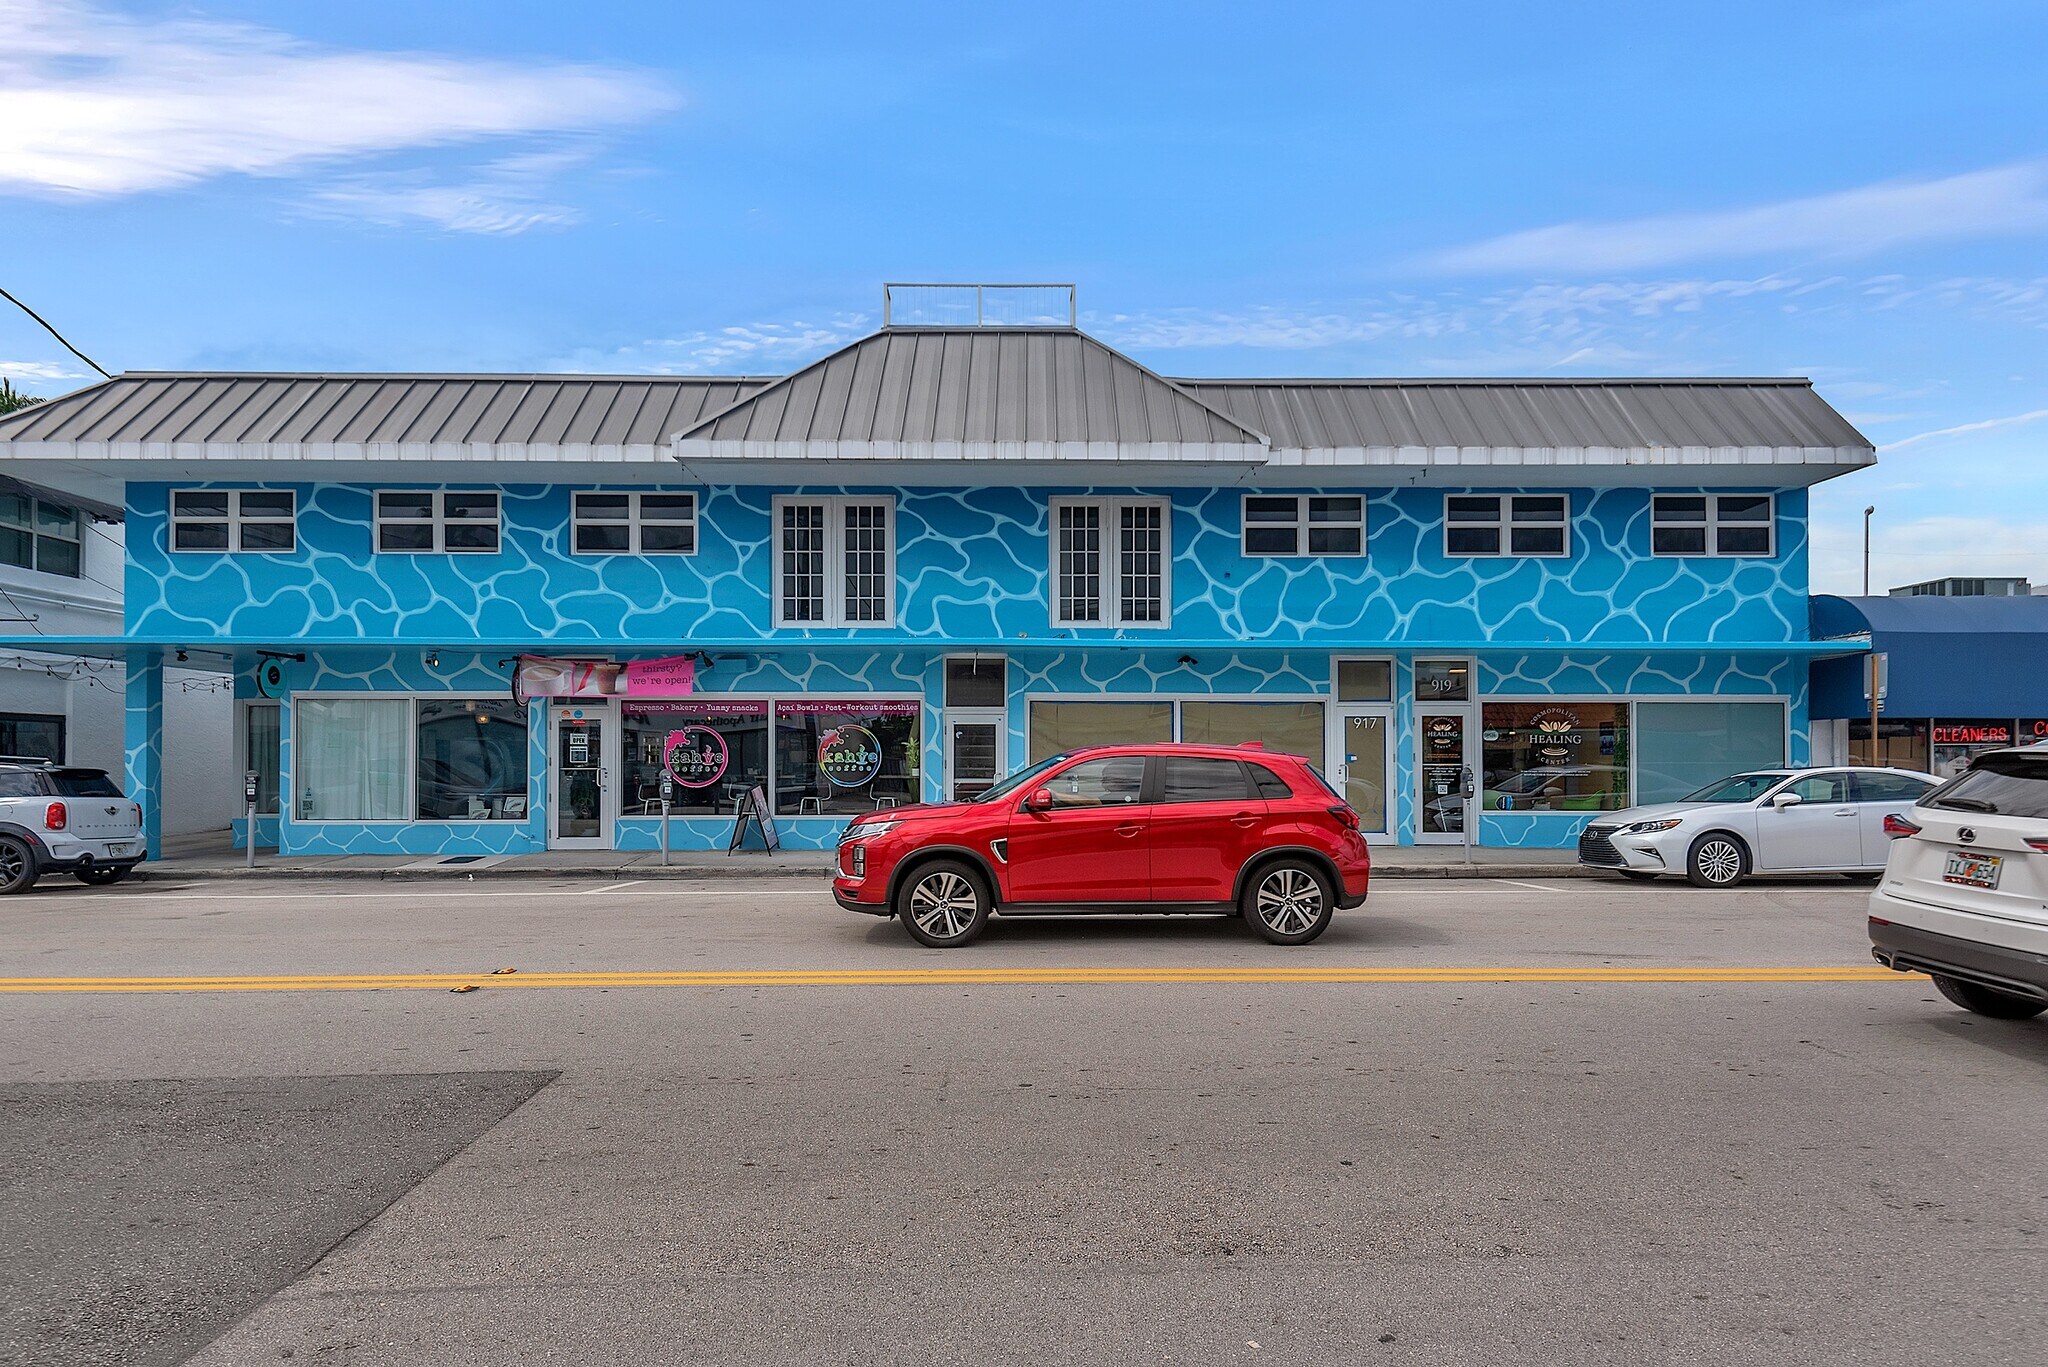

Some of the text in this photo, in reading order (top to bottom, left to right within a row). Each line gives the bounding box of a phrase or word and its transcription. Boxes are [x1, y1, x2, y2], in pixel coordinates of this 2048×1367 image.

[642, 664, 682, 673] thirsty?
[632, 677, 661, 685] we're
[1431, 679, 1452, 691] 919
[629, 704, 664, 712] Espresso
[671, 704, 698, 712] Bakery
[706, 704, 730, 712] Yummy
[1529, 707, 1581, 726] COSMOPOLITAN
[1353, 717, 1377, 729] 917
[2034, 721, 2048, 735] C
[1529, 734, 1582, 744] HEALING
[1933, 727, 2007, 742] CLEANERS
[668, 749, 725, 765] kahve
[822, 748, 878, 764] kahve
[1540, 756, 1571, 765] CENTER
